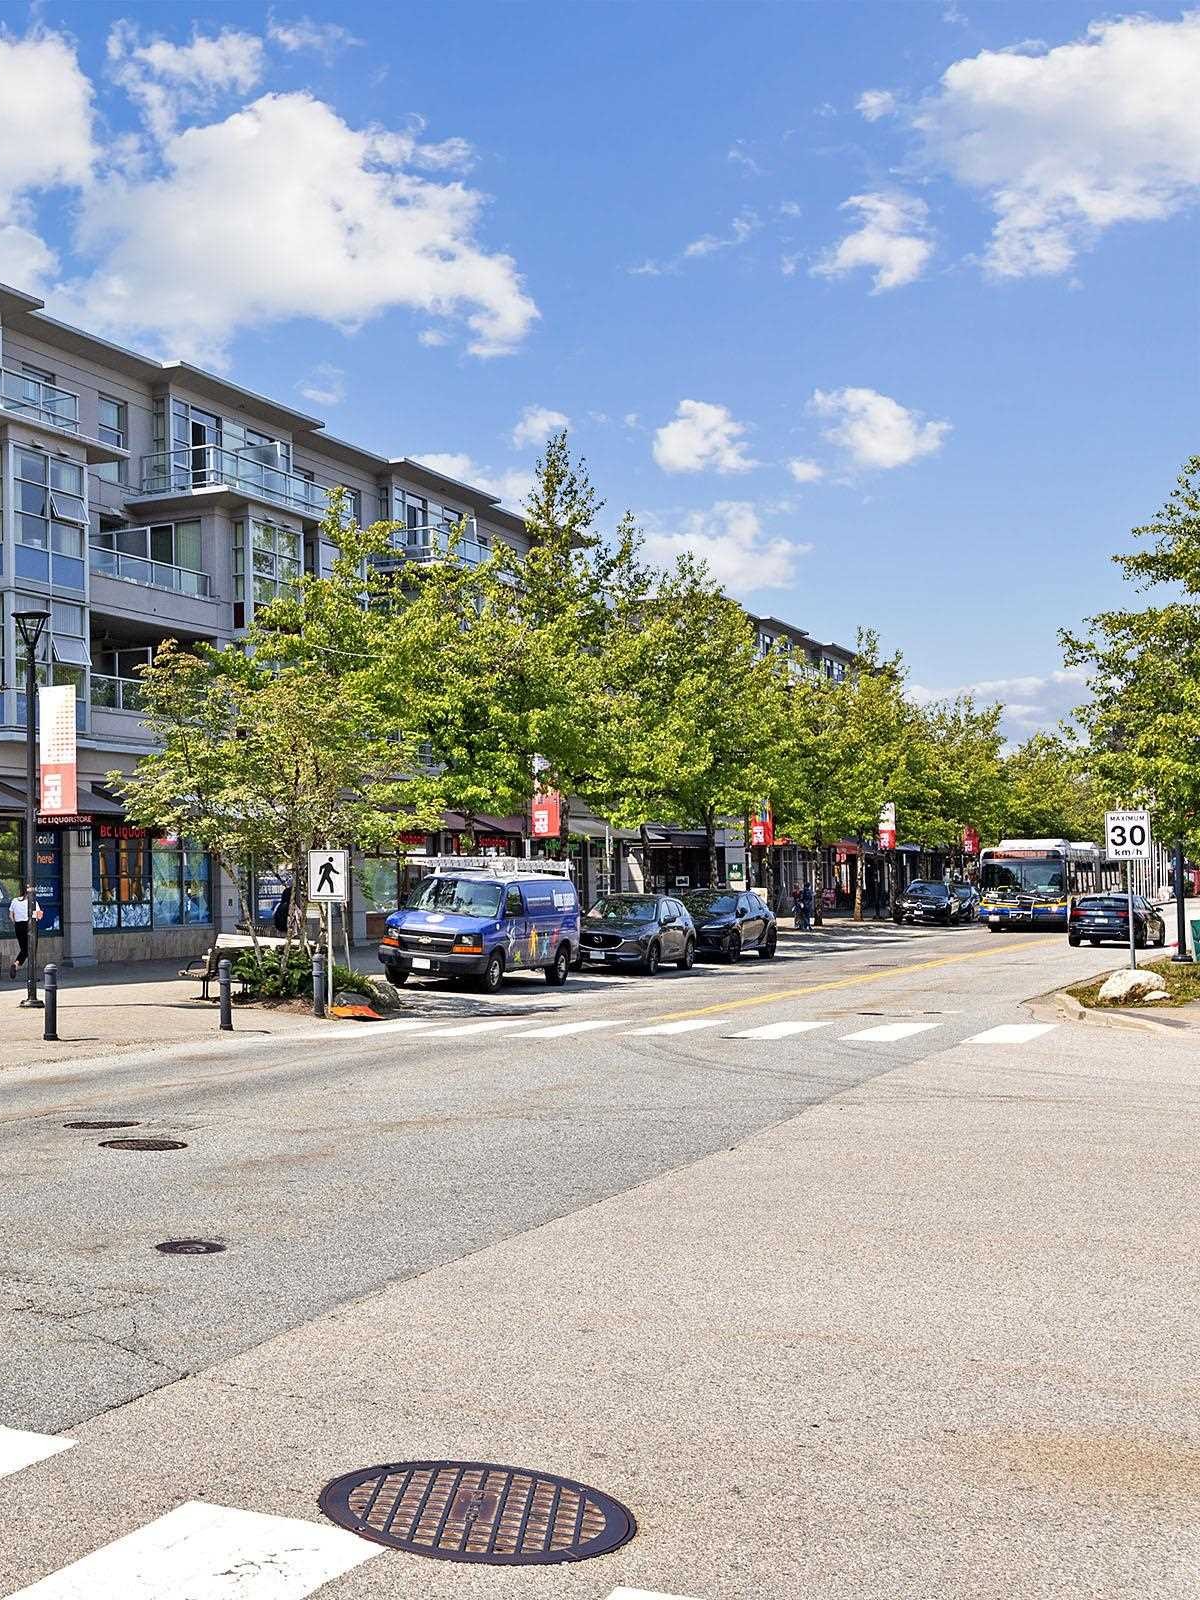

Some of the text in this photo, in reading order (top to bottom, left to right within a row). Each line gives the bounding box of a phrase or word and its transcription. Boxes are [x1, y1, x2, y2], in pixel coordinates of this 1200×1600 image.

[100, 824, 112, 838] BC
[1110, 825, 1146, 846] 30
[38, 833, 55, 844] cold
[1114, 848, 1143, 856] km/h
